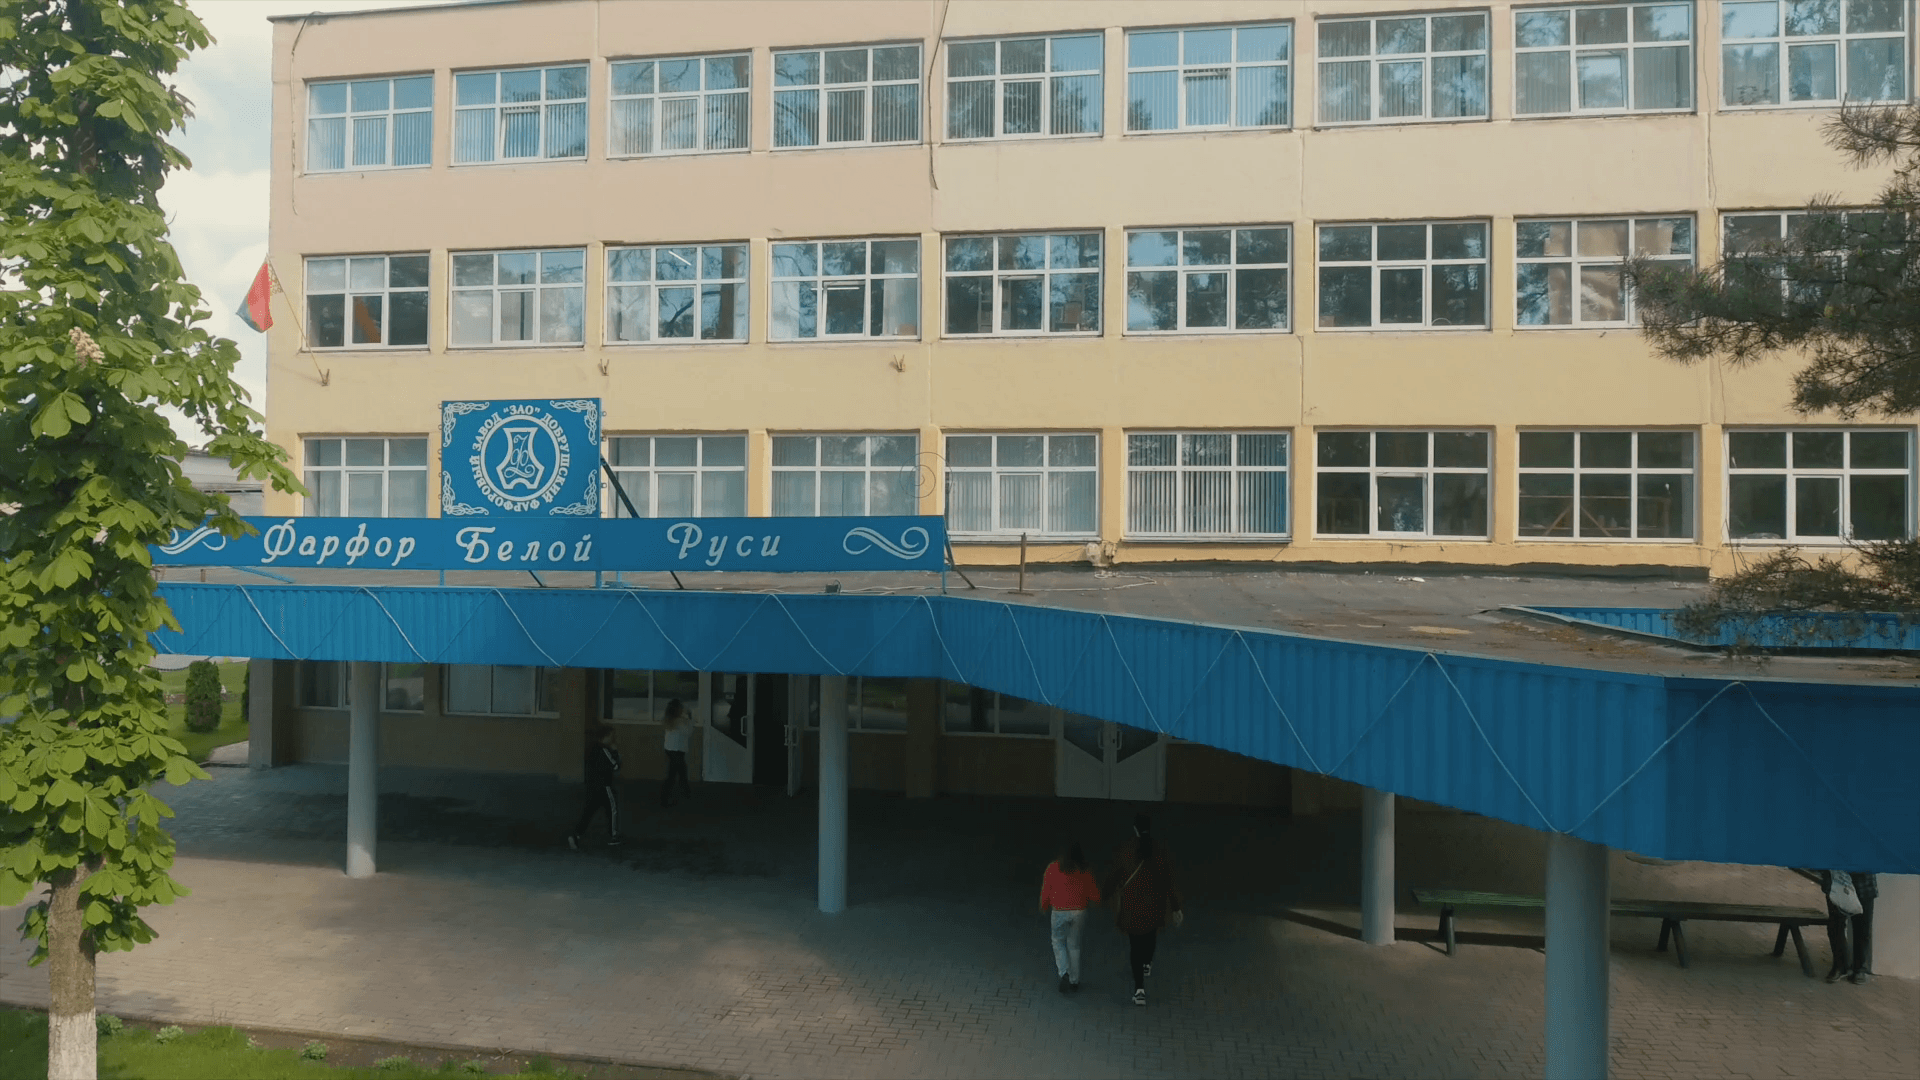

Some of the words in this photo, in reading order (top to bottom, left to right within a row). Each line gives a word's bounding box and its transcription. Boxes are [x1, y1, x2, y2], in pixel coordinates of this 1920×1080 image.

[472, 412, 504, 452] ЗАВОД
[540, 412, 571, 503] ДОБРУШСКИЙ
[469, 455, 540, 512] ФАРФОРОВЫЙ
[261, 518, 416, 566] Фарфор
[456, 526, 592, 562] Белой
[667, 523, 781, 566] Руси
